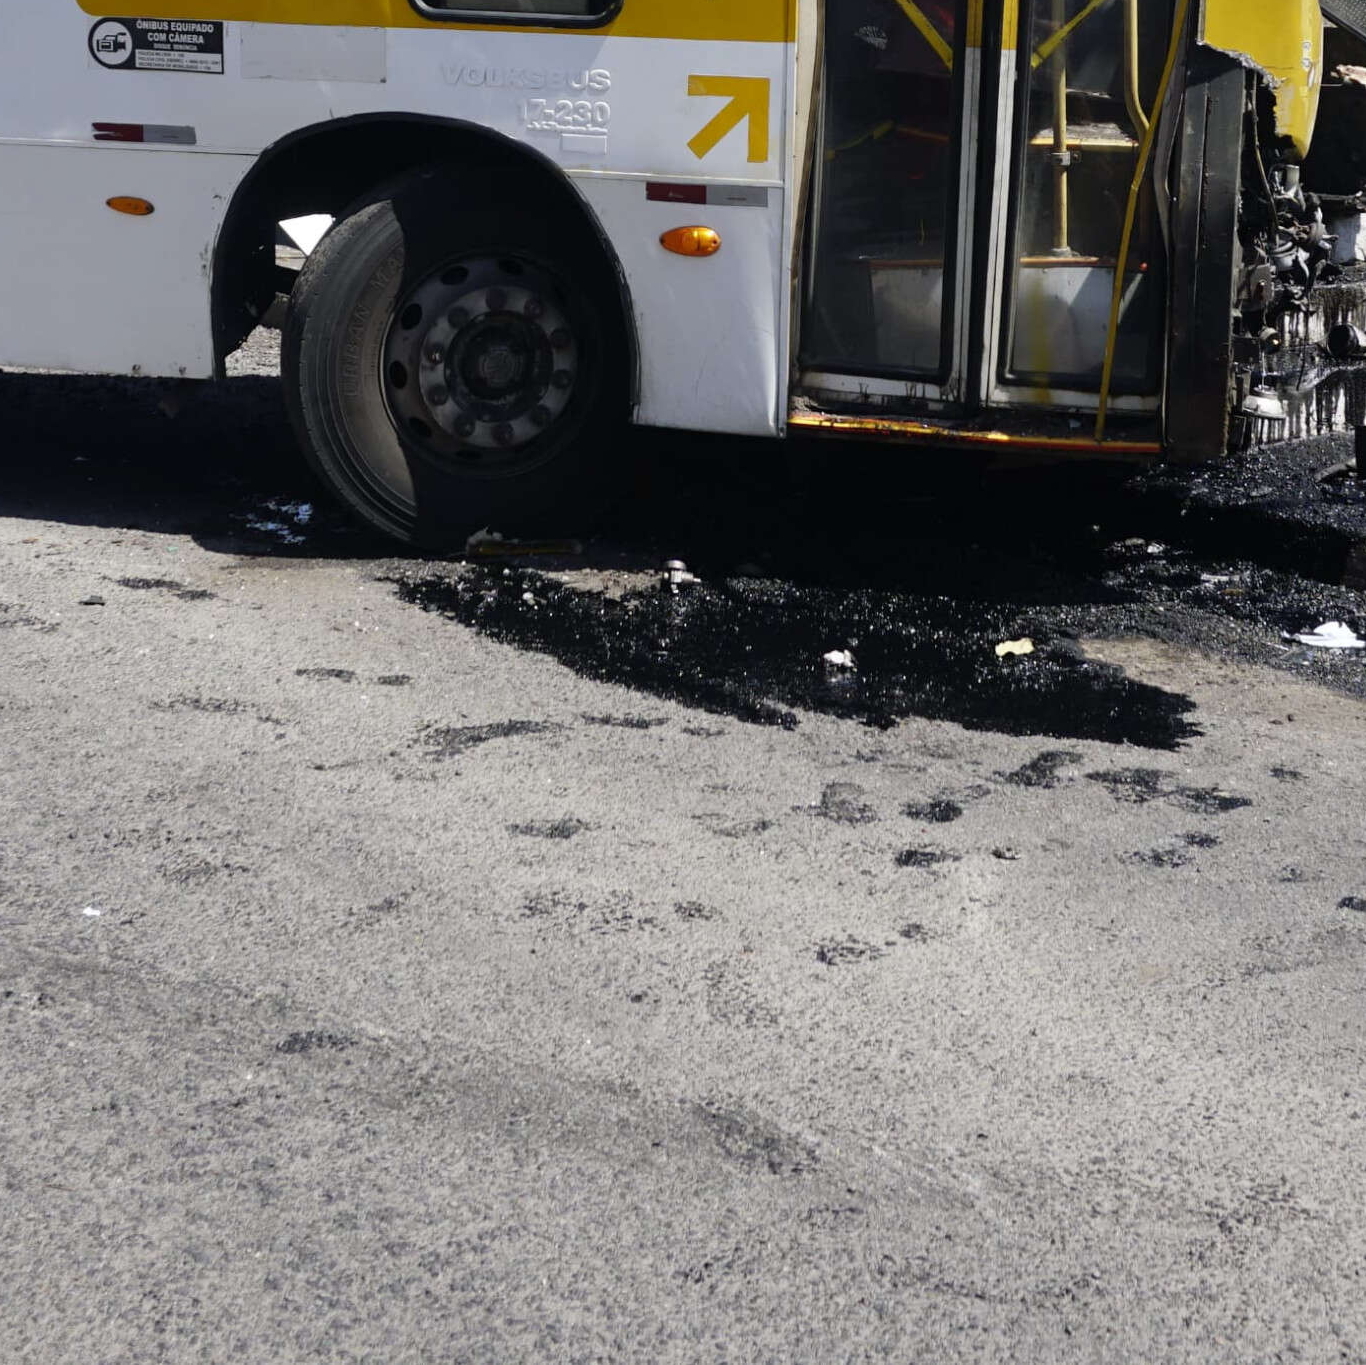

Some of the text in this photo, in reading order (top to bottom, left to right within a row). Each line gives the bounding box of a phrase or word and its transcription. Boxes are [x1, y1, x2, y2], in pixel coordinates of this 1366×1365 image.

[135, 19, 214, 33] ÔNIBUS EQUIPADO
[147, 31, 204, 44] COM CÂMERA
[440, 64, 612, 90] VOLKSBUS
[518, 97, 612, 124] 17-230
